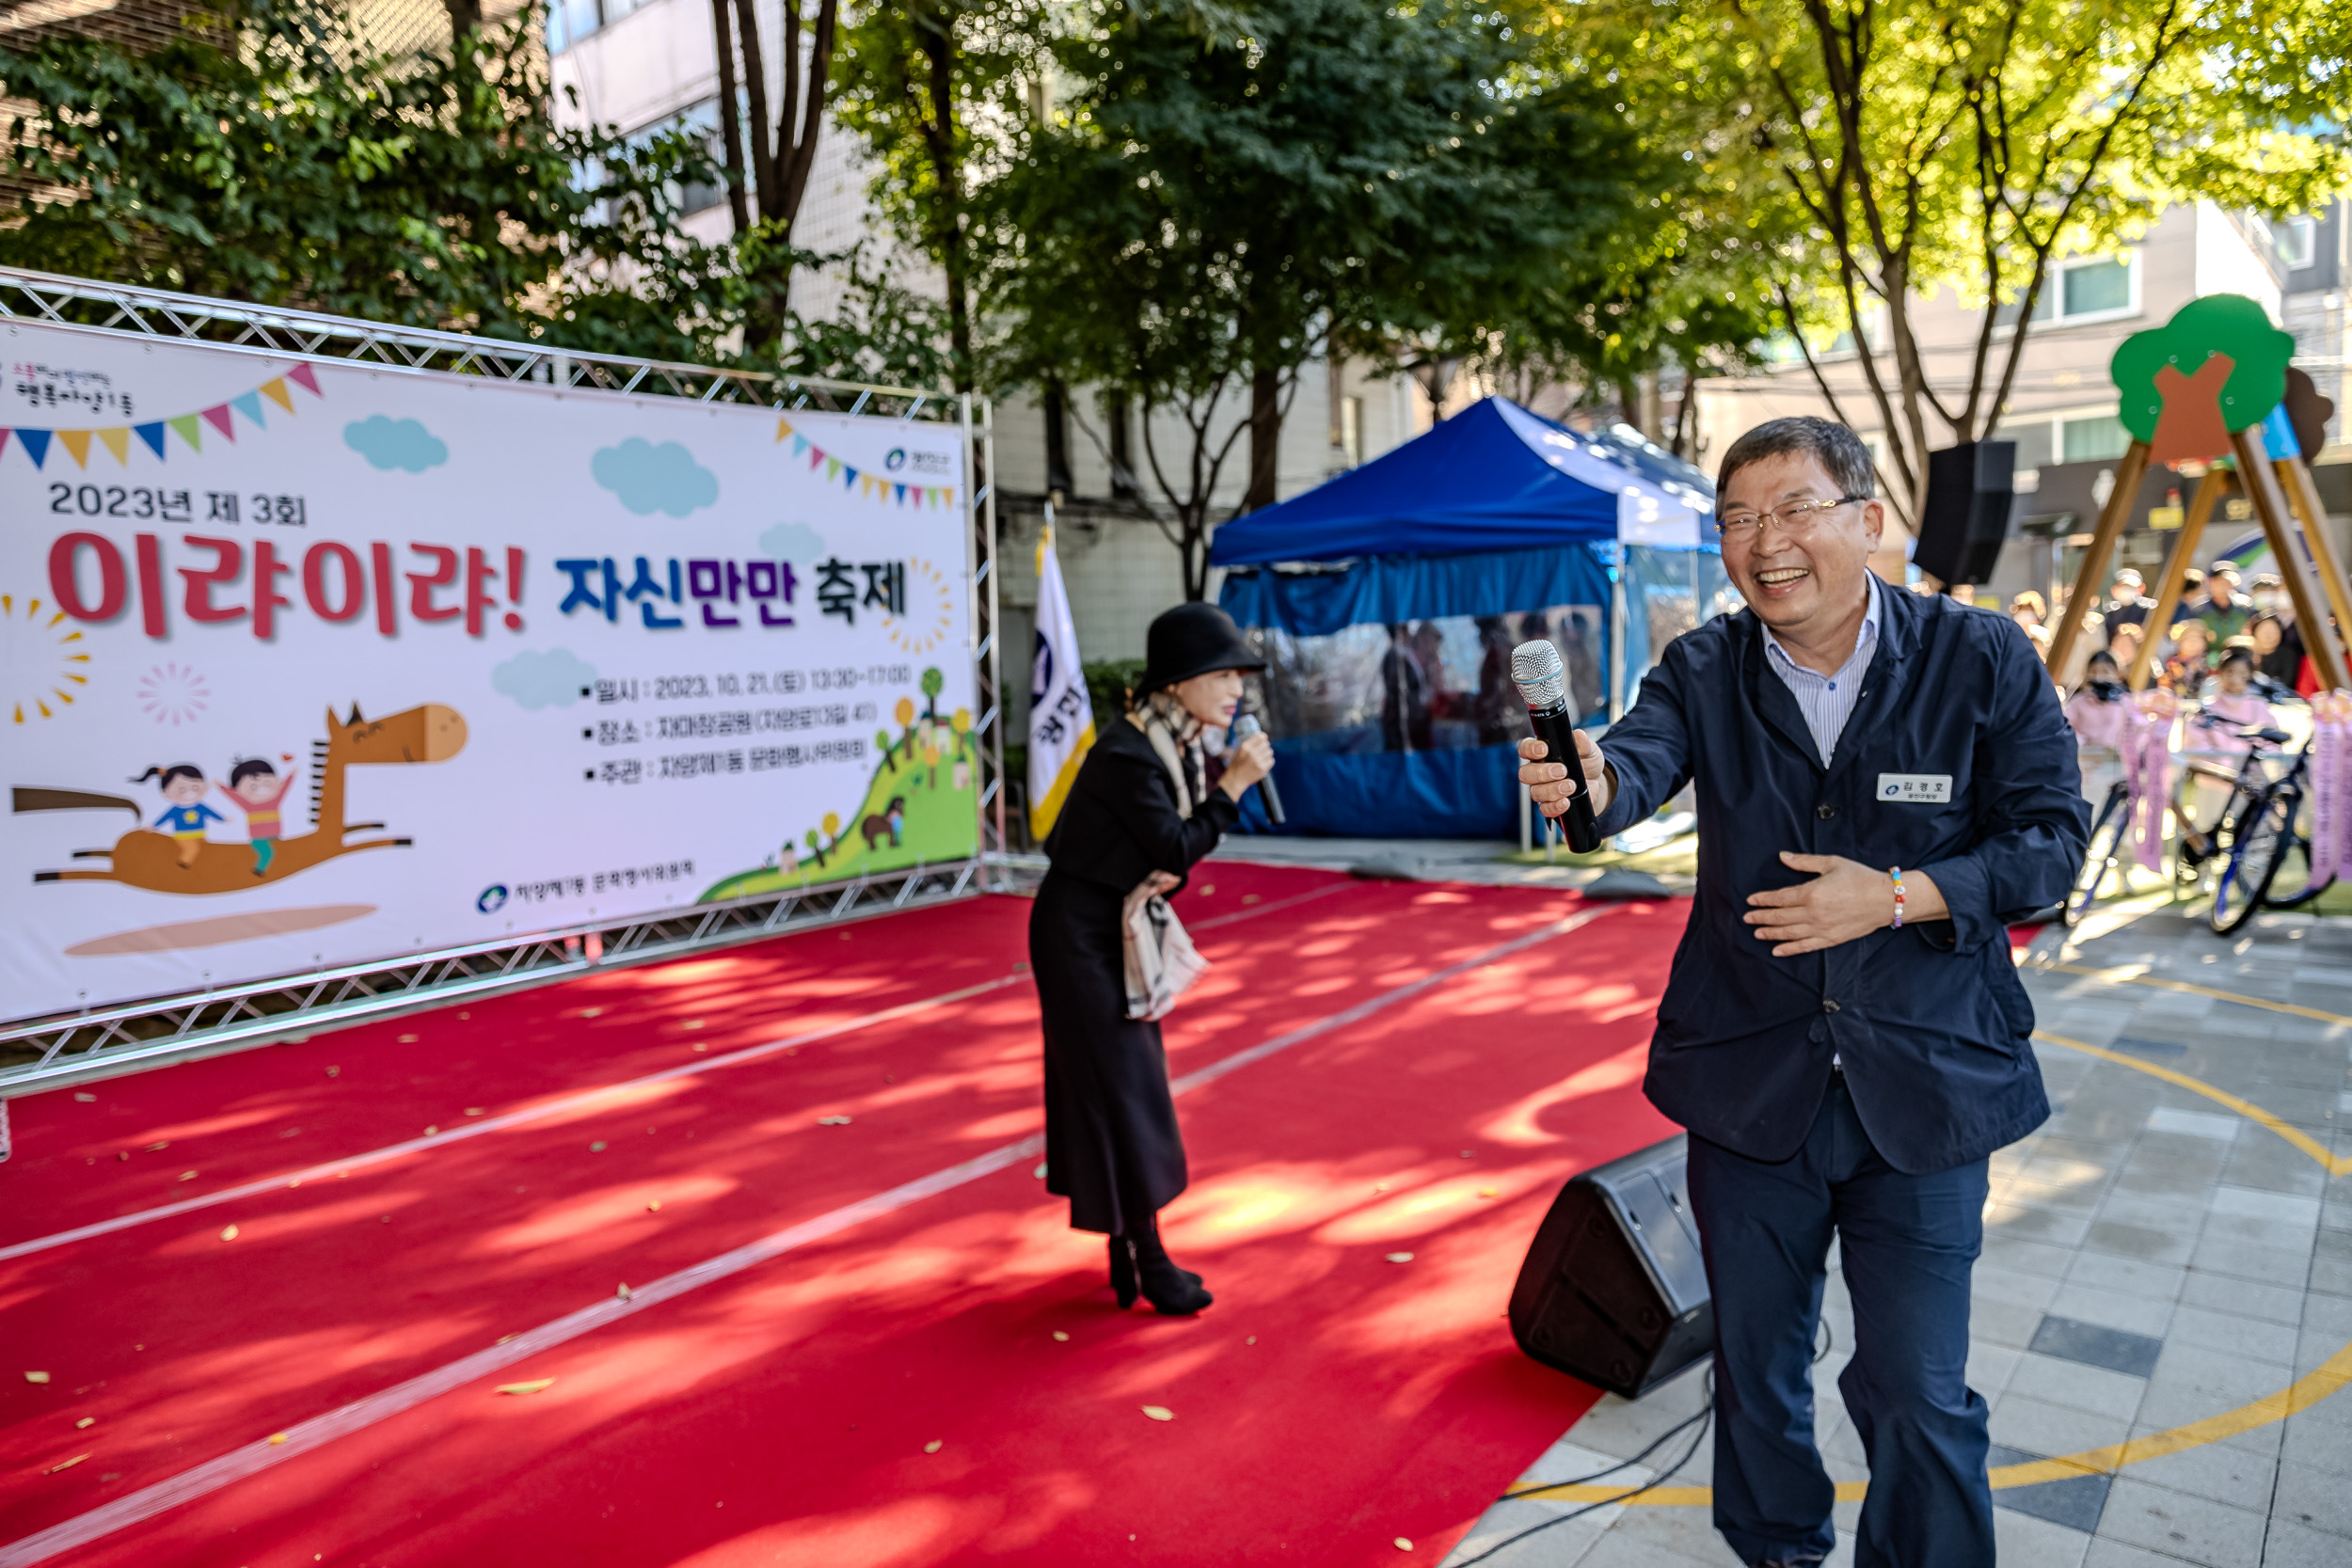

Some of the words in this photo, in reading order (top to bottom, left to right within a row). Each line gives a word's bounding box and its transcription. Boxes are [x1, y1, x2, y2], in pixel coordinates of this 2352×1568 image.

[49, 482, 193, 523] 2023년
[206, 490, 241, 525] 제
[252, 494, 307, 527] 3회
[47, 530, 526, 641] 이랴이랴!
[555, 556, 799, 628] 자신만만
[815, 556, 908, 625] 축제
[595, 677, 638, 705] 일시
[655, 674, 712, 700] 2023.
[716, 673, 743, 697] 10.
[597, 719, 642, 746] 장소
[600, 758, 642, 786] 주관
